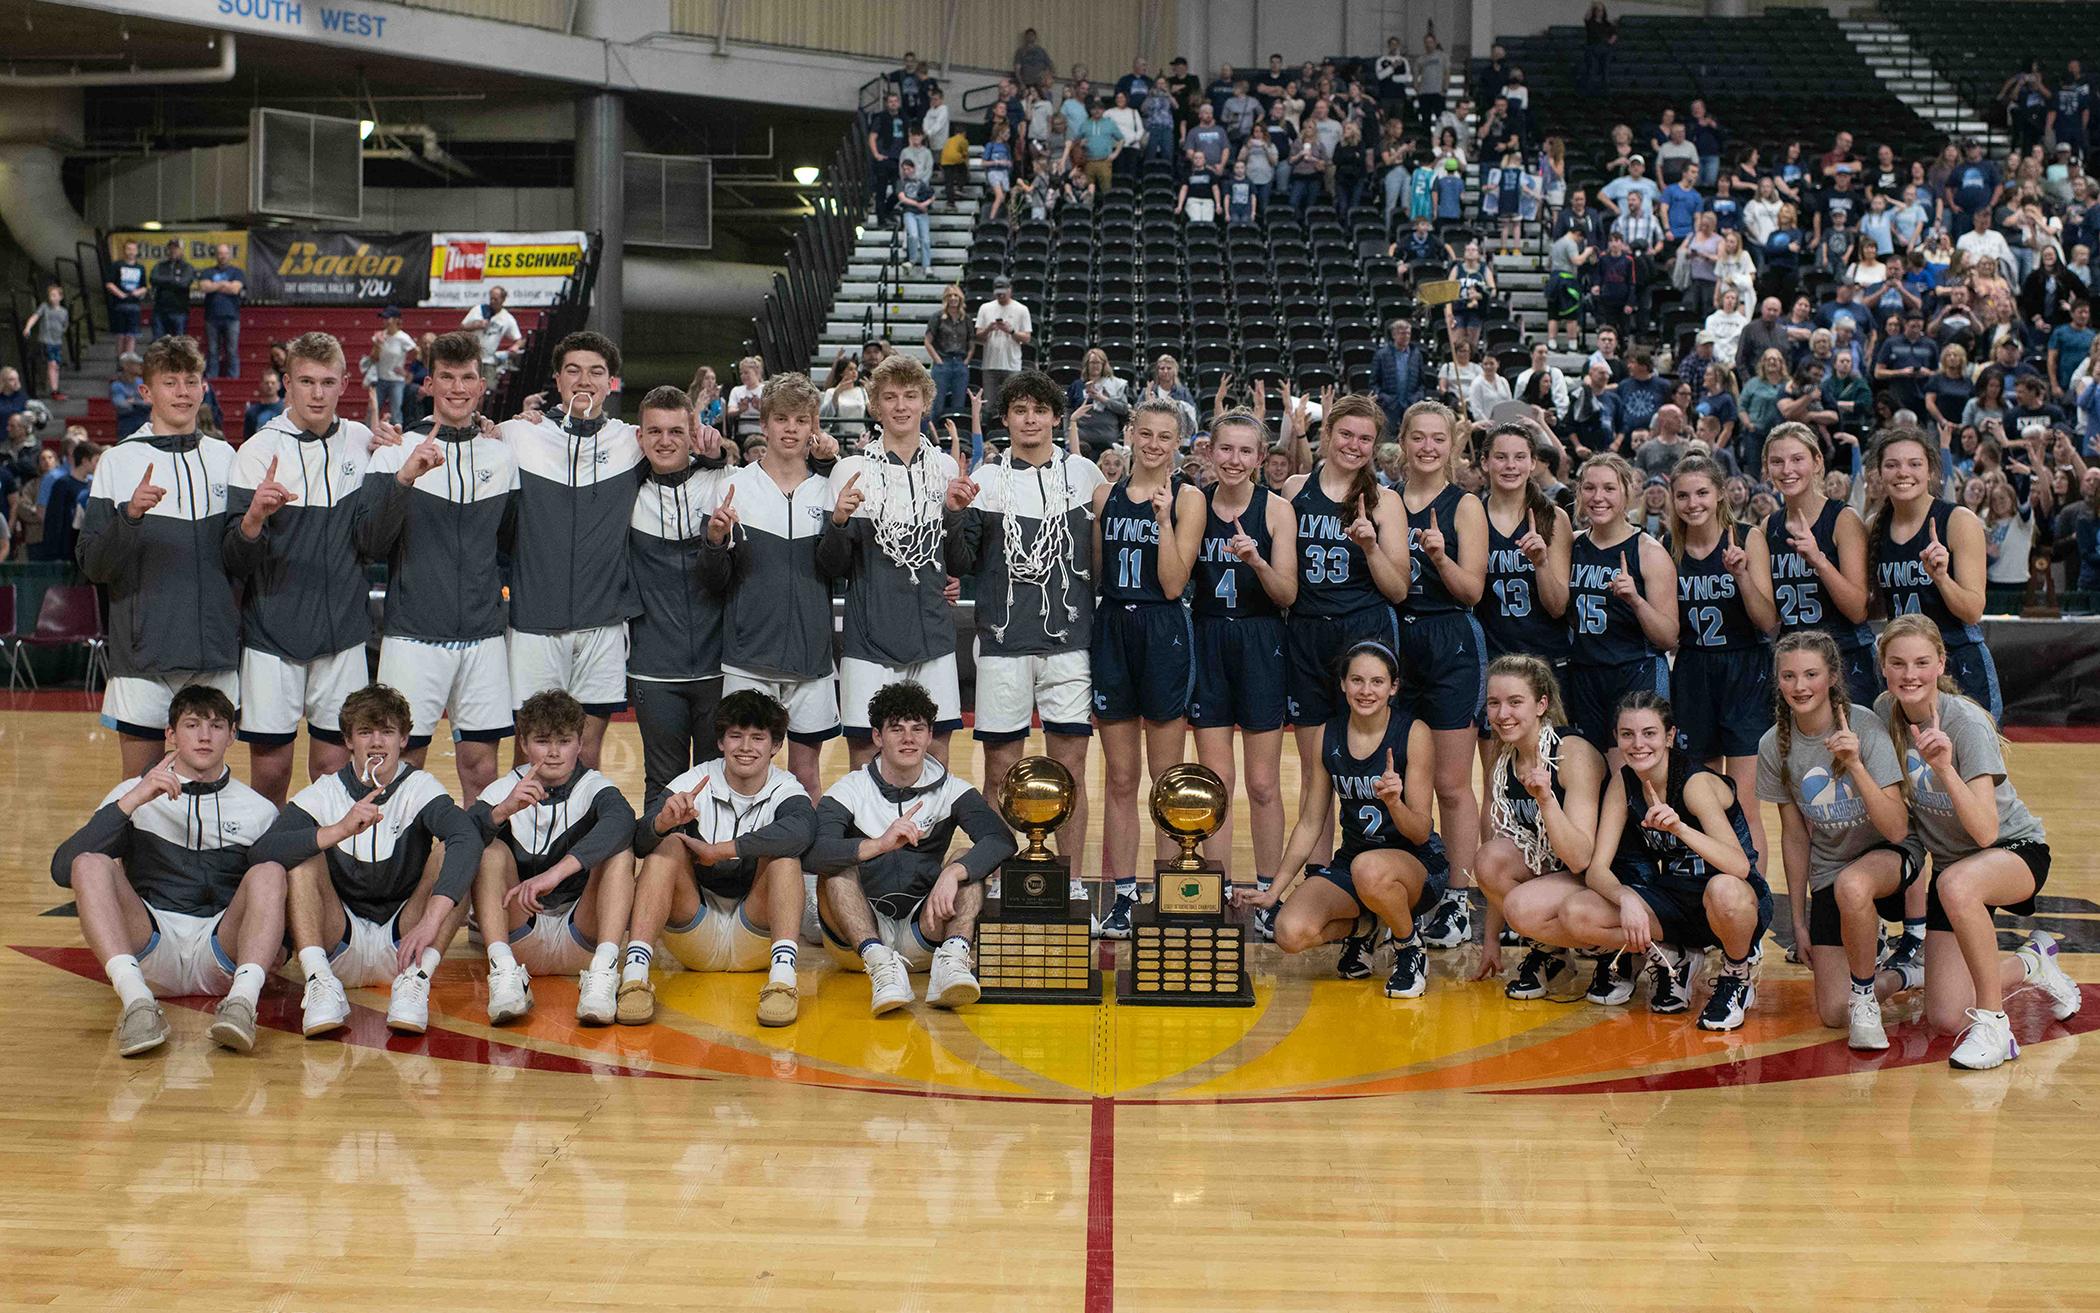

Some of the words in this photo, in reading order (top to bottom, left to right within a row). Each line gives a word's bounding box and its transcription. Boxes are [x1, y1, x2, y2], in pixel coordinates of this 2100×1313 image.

[218, 0, 301, 25] SOUTH
[320, 8, 387, 39] WEST
[278, 242, 403, 276] Baden
[488, 254, 512, 268] LES
[515, 252, 577, 268] SCHWAB
[1104, 516, 1161, 545] LYNCS
[1298, 514, 1353, 541] LYNC
[1118, 547, 1142, 588] 11
[1305, 544, 1350, 583] 33
[1769, 553, 1819, 579] LYNC
[1215, 568, 1237, 608] 4
[1492, 578, 1532, 617] 13
[1776, 583, 1823, 626] 25
[1576, 593, 1607, 634] 15
[1688, 606, 1727, 647] 12
[1332, 774, 1383, 800] LYNC
[1359, 805, 1385, 841] 2
